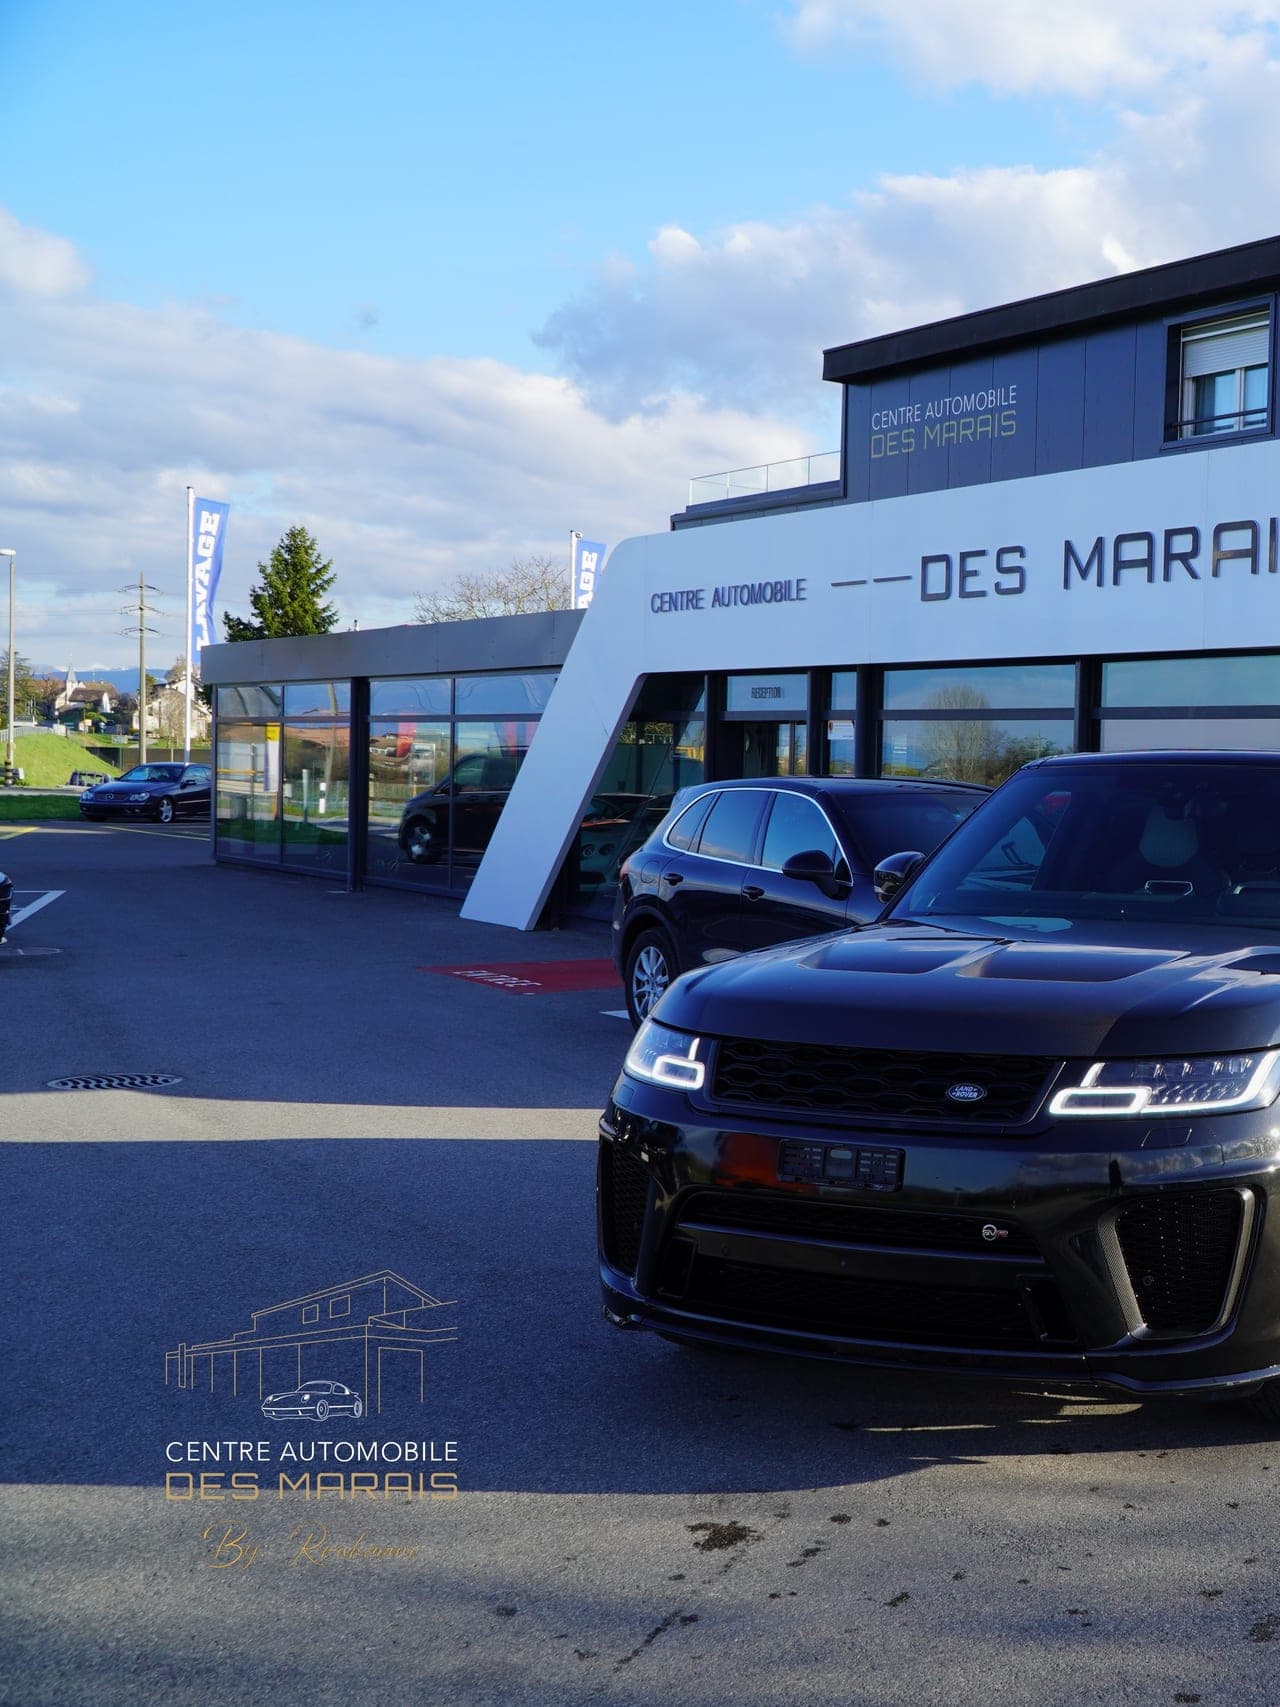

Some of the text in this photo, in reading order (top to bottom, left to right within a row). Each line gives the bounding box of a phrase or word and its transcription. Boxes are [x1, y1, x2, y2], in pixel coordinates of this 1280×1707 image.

[870, 410, 1017, 459] DES MARAIS
[871, 385, 1017, 431] CENTRE AUTOMOBILE
[195, 510, 221, 651] LAVAGE
[578, 550, 598, 608] AGE
[650, 588, 705, 614] CENTRE
[711, 578, 808, 608] AUTOMOBILE
[920, 545, 1027, 601] DES
